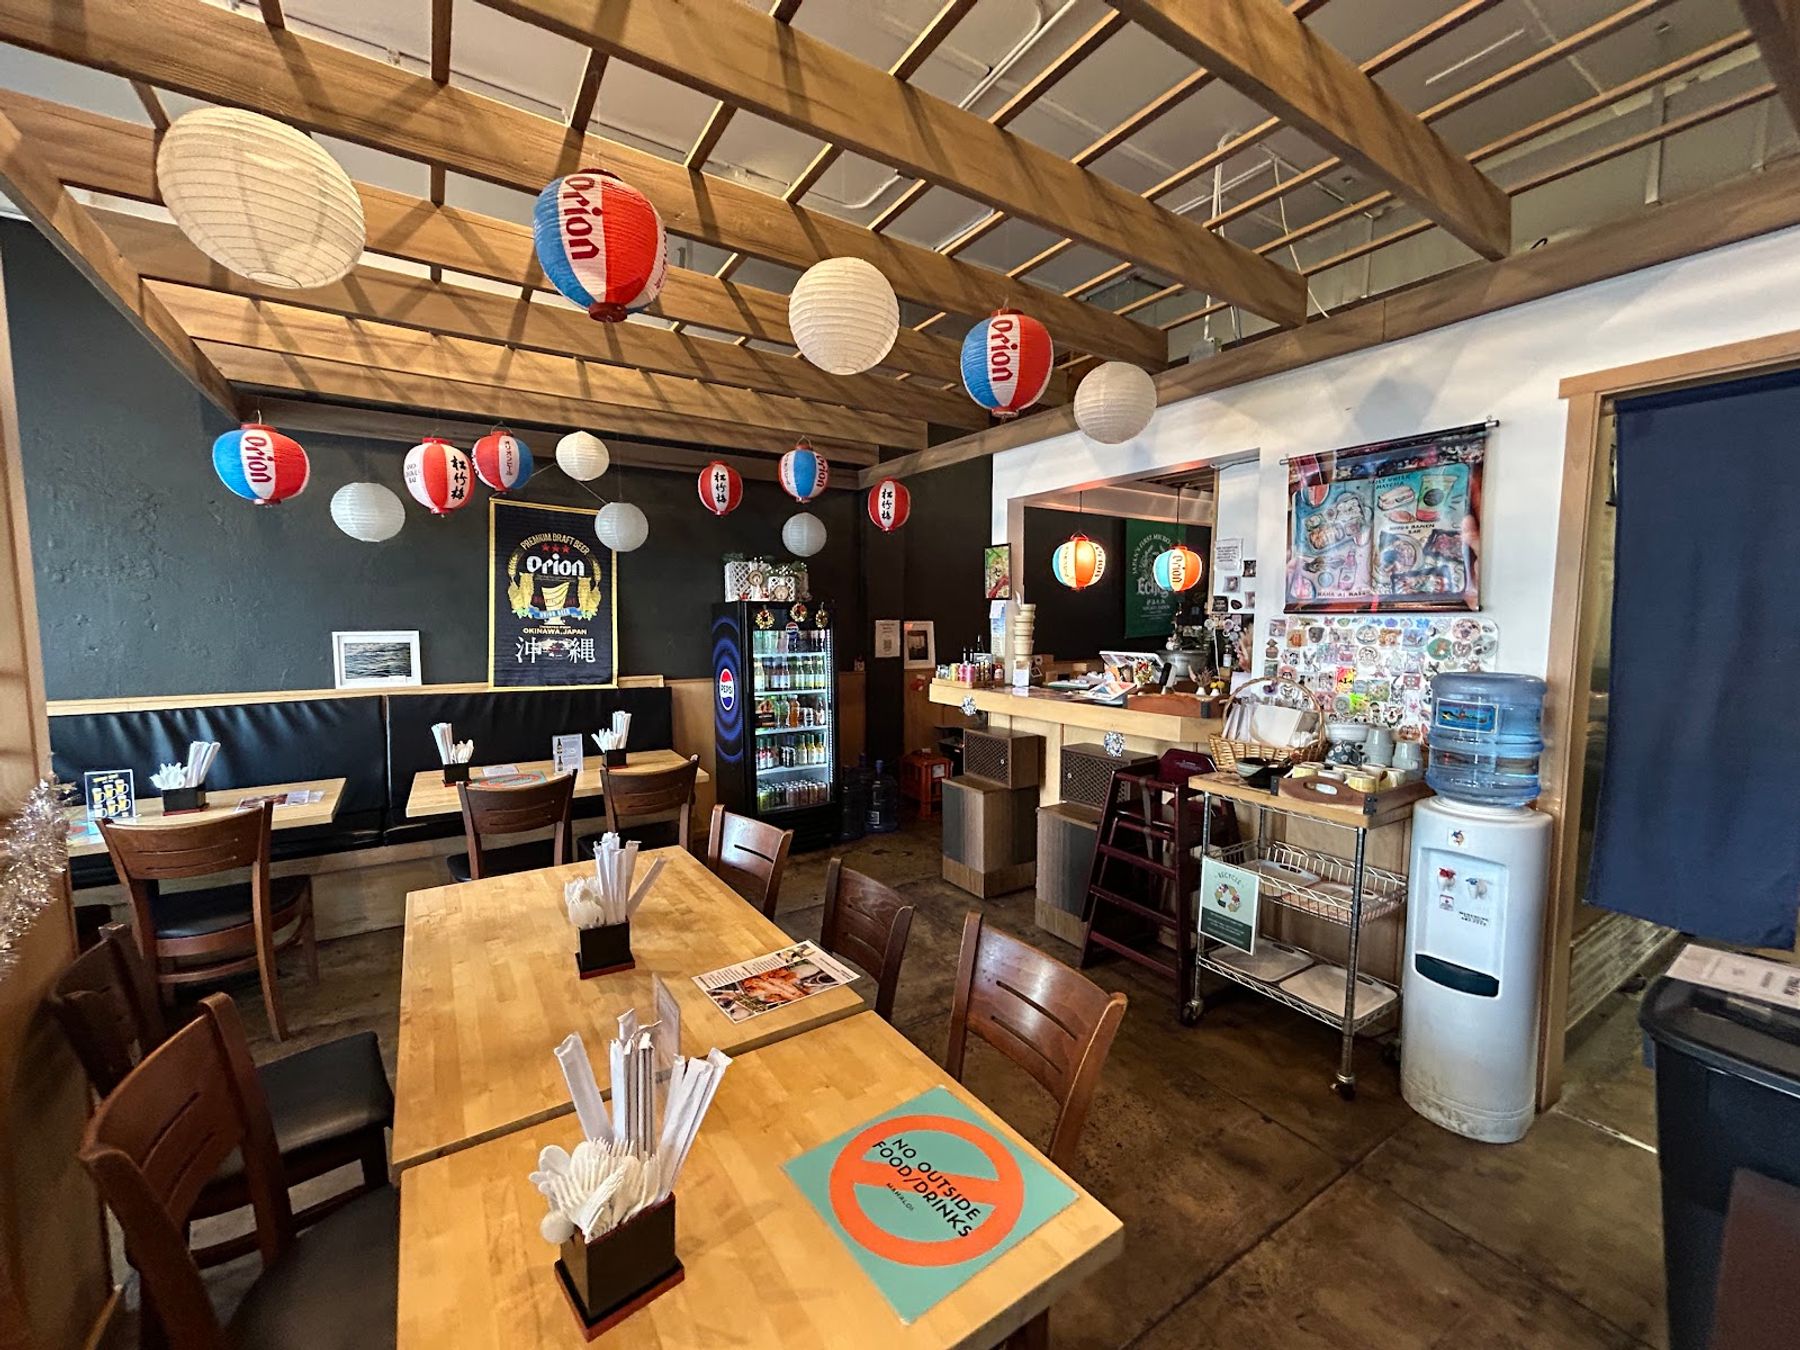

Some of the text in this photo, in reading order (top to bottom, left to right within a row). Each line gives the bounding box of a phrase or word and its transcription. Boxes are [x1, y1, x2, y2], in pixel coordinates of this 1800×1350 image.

[562, 176, 603, 260] Orion
[991, 319, 1018, 382] Orion
[244, 436, 274, 483] Orion
[815, 455, 829, 488] Orion
[520, 532, 591, 555] PREMIUM DRAFT BEER
[526, 552, 585, 577] Orion
[563, 627, 587, 635] JAPAN
[872, 1140, 973, 1238] FOOD/DRINKS
[892, 1138, 981, 1221] NO OUTSIDE
